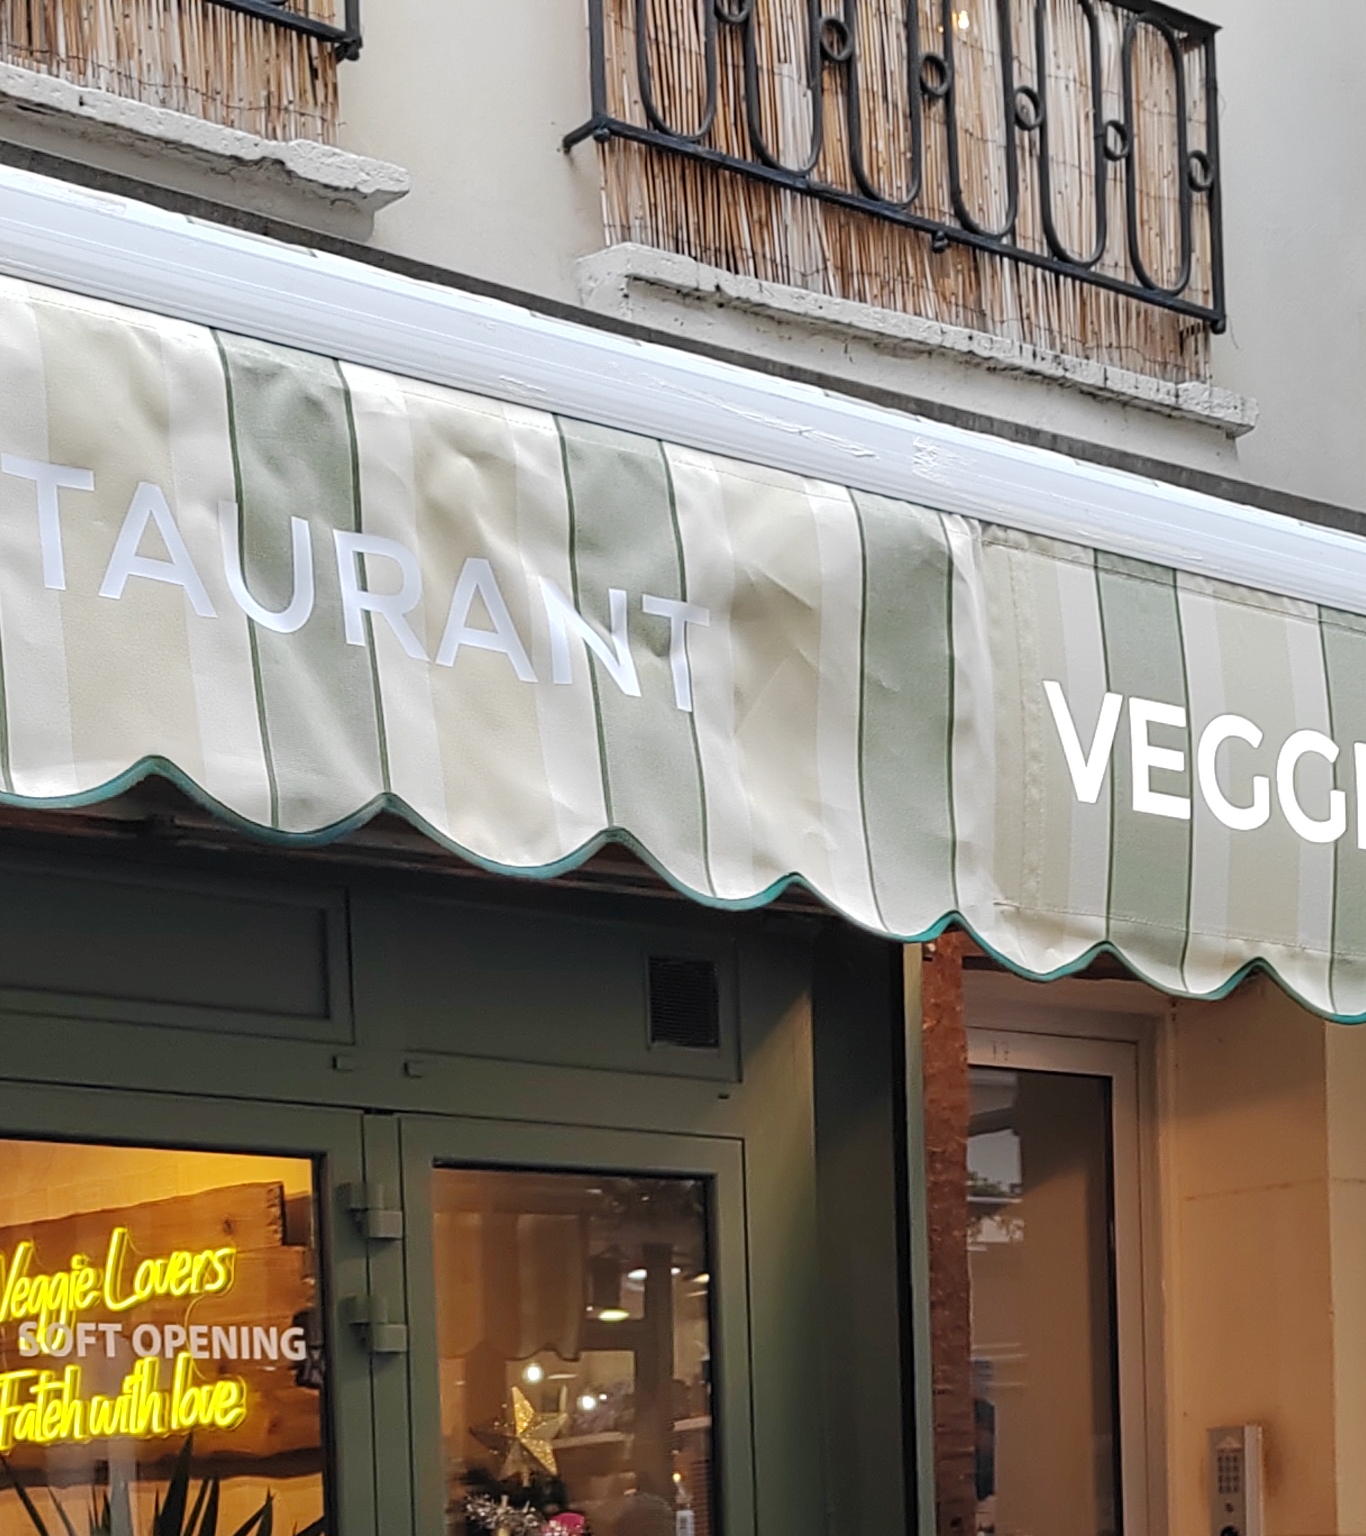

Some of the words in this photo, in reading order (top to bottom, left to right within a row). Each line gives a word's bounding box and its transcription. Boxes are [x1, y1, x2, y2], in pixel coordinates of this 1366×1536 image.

[103, 1227, 236, 1312] Lovers
[18, 1321, 123, 1360] SOFT
[132, 1323, 308, 1361] OPENING
[89, 1356, 165, 1436] with
[172, 1352, 246, 1429] love
